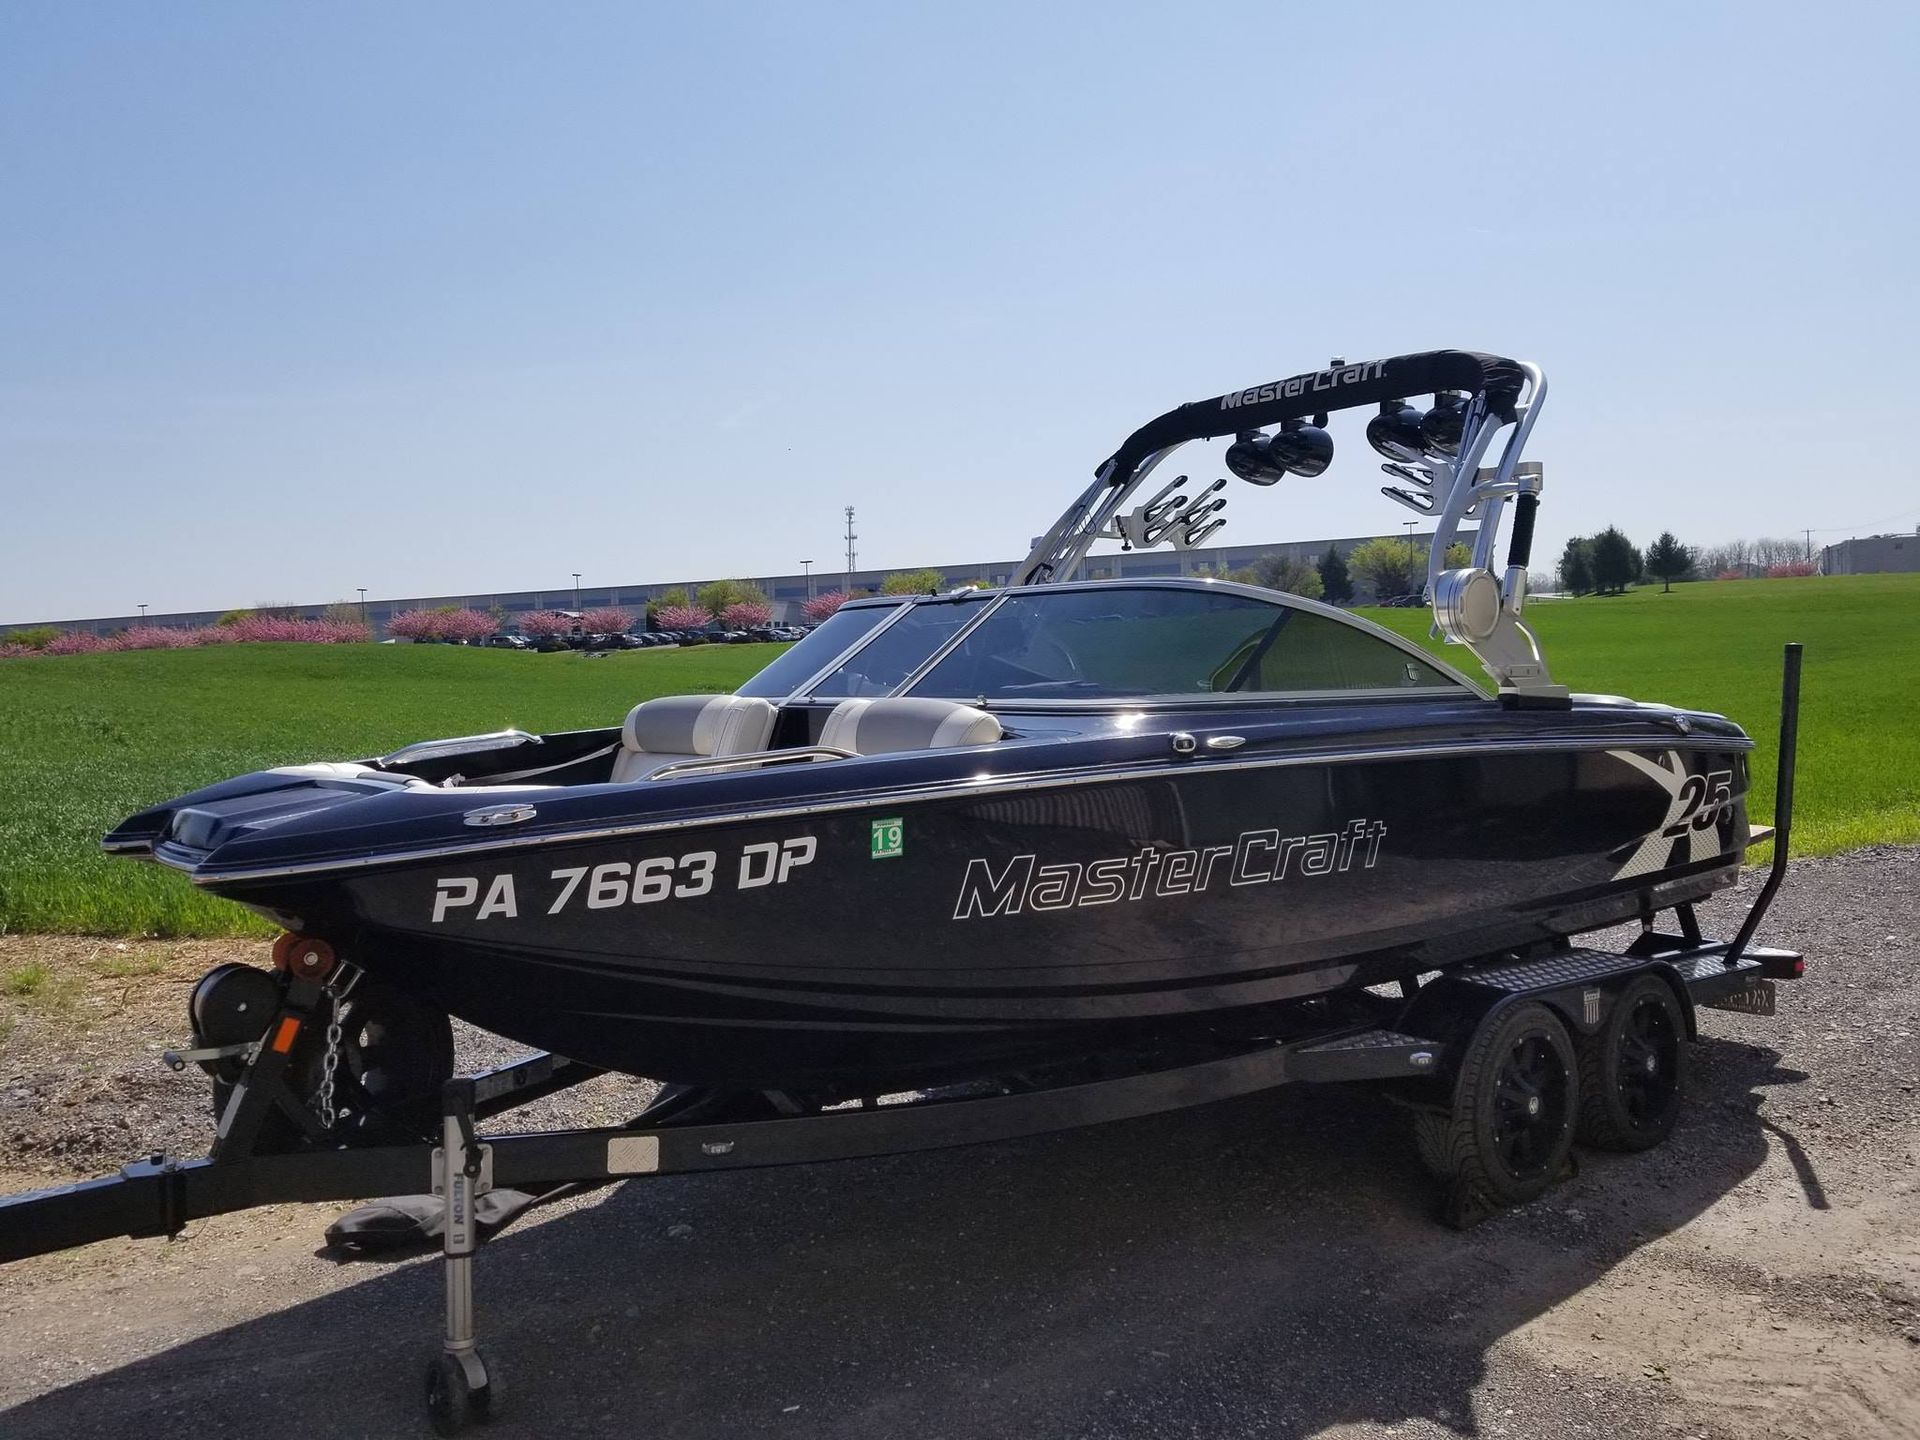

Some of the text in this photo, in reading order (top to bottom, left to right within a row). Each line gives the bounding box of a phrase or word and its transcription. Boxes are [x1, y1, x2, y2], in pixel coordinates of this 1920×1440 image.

[1220, 359, 1388, 411] MasterCraft
[1661, 769, 1733, 839] 25
[873, 826, 902, 850] 19
[952, 818, 1388, 920] MasterCraft
[432, 836, 818, 923] PA 7663 DP
[453, 1172, 465, 1226] FULTON
